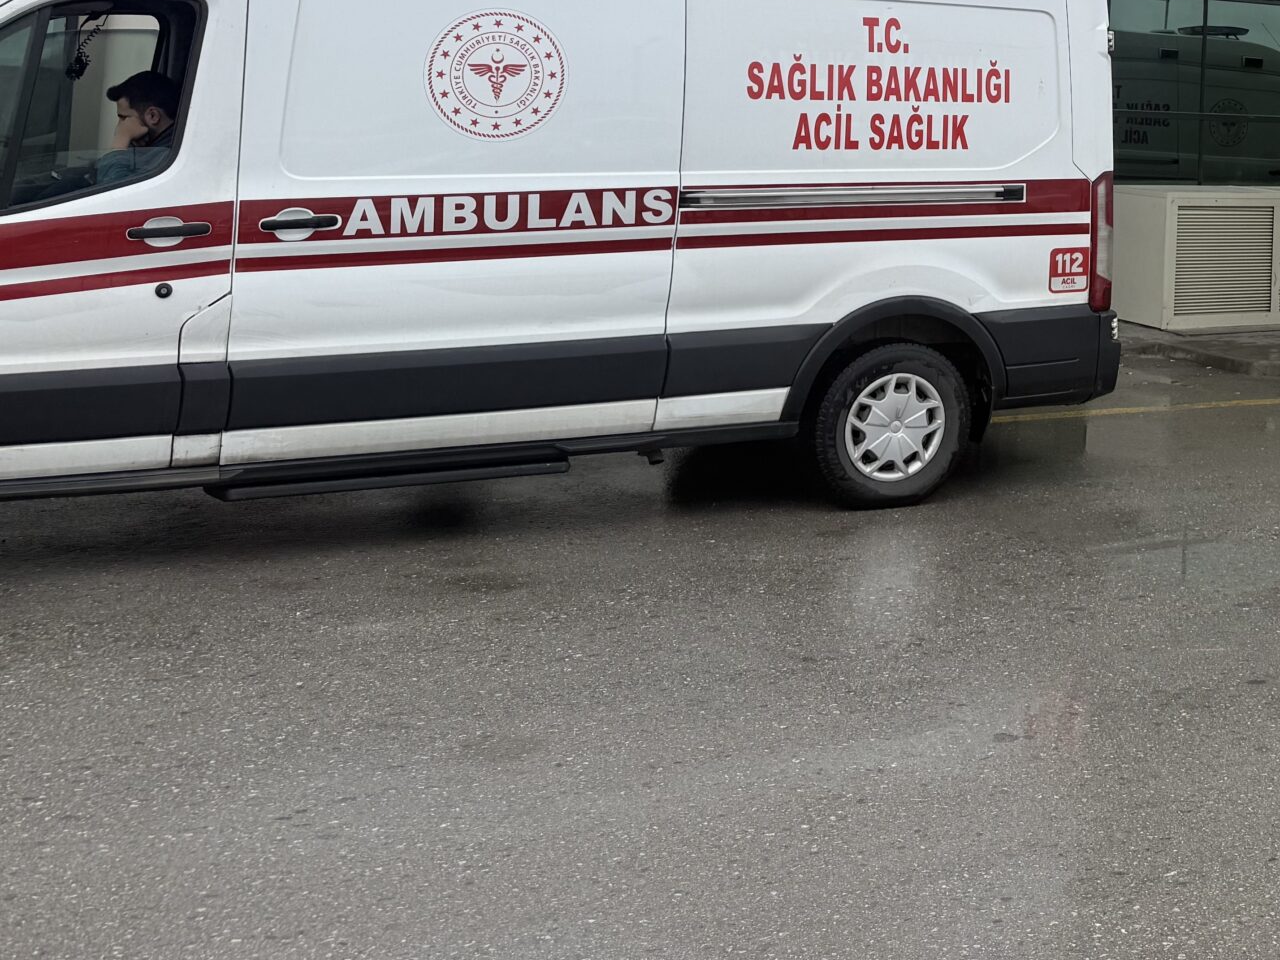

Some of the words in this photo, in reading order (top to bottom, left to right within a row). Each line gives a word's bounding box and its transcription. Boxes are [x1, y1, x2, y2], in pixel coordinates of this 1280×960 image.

[863, 16, 909, 54] T.C.
[746, 53, 857, 101] SAĞLIK
[866, 59, 1011, 104] BAKANLIĞI
[792, 103, 860, 150] ACİL
[868, 104, 970, 151] SAĞLIK
[342, 188, 674, 237] AMBULANS
[1055, 251, 1084, 274] 112
